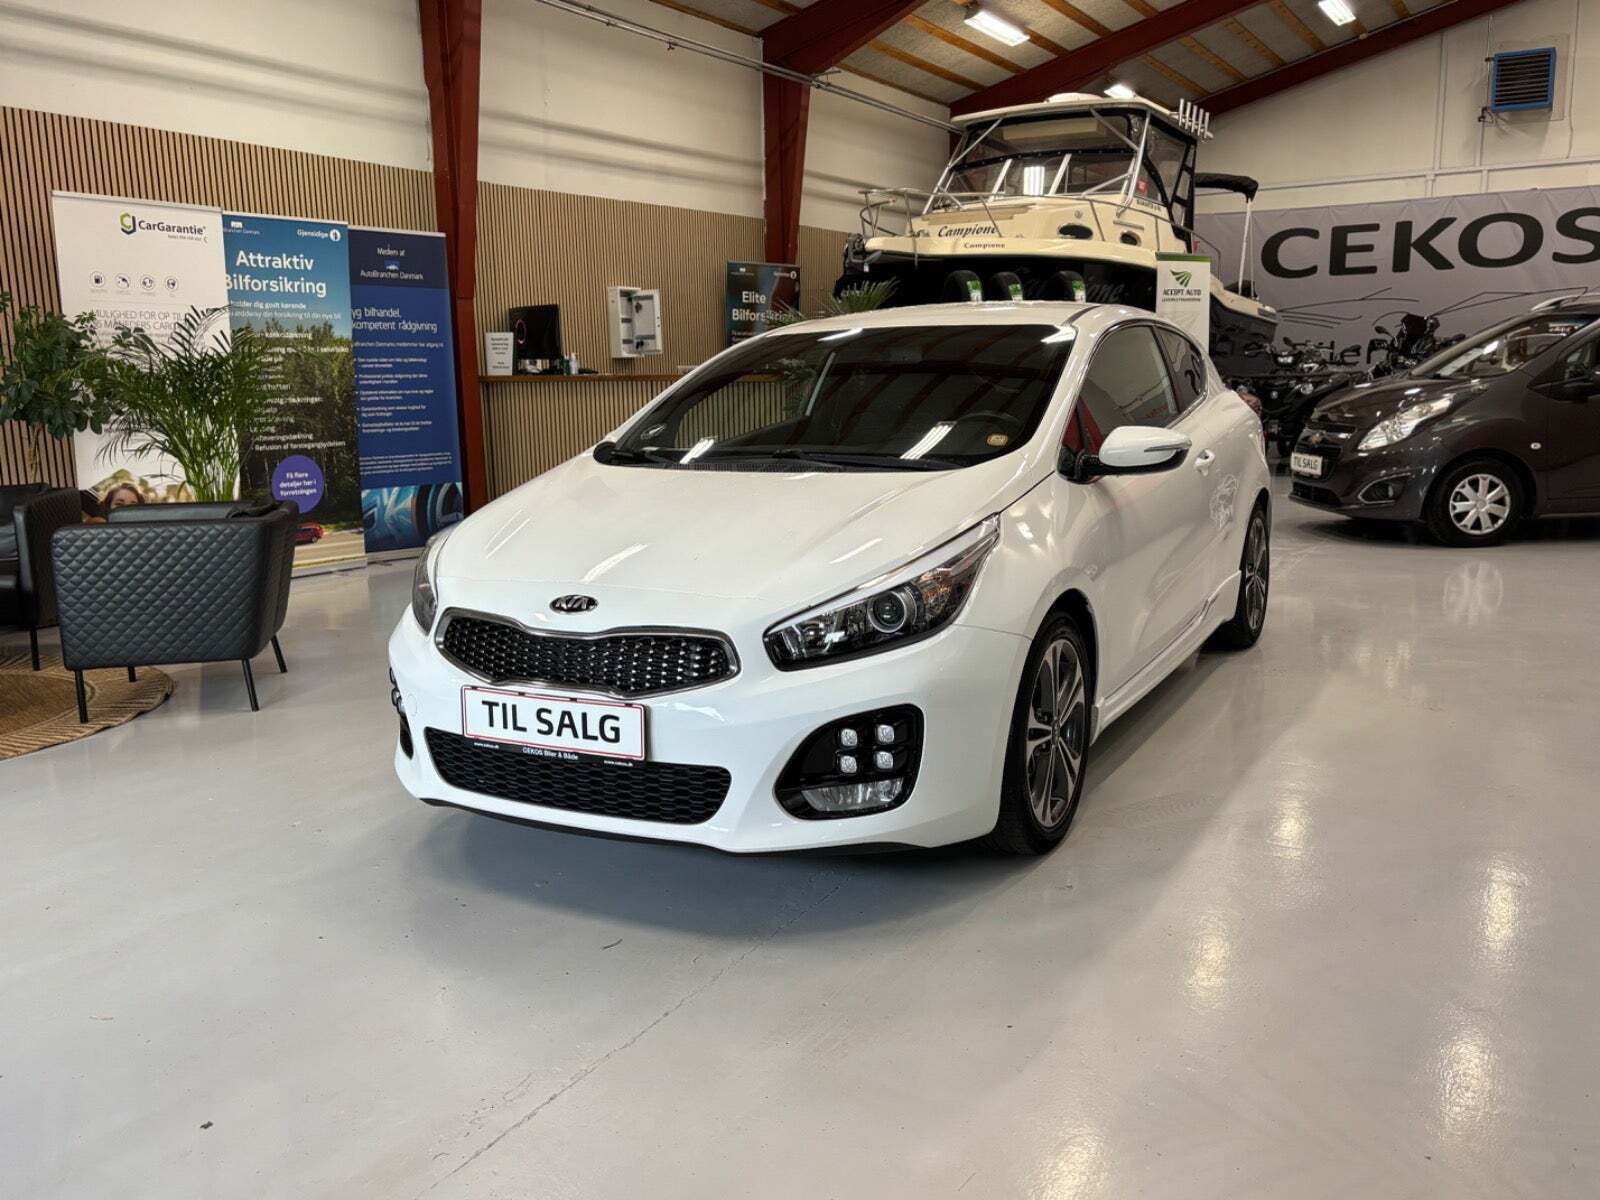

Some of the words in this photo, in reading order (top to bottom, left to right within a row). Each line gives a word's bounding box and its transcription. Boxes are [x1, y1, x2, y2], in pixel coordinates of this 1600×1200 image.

[138, 219, 204, 236] CarGarantie
[296, 228, 328, 239] Gjensidige
[938, 223, 997, 238] Campione
[1261, 206, 1600, 279] CEKOS
[235, 249, 315, 271] Attraktiv
[400, 271, 424, 280] Danmark
[225, 273, 327, 299] Bilforsikring
[742, 290, 766, 304] Elite
[554, 594, 594, 610] KIA
[481, 699, 528, 733] TIL
[535, 706, 621, 744] SALG
